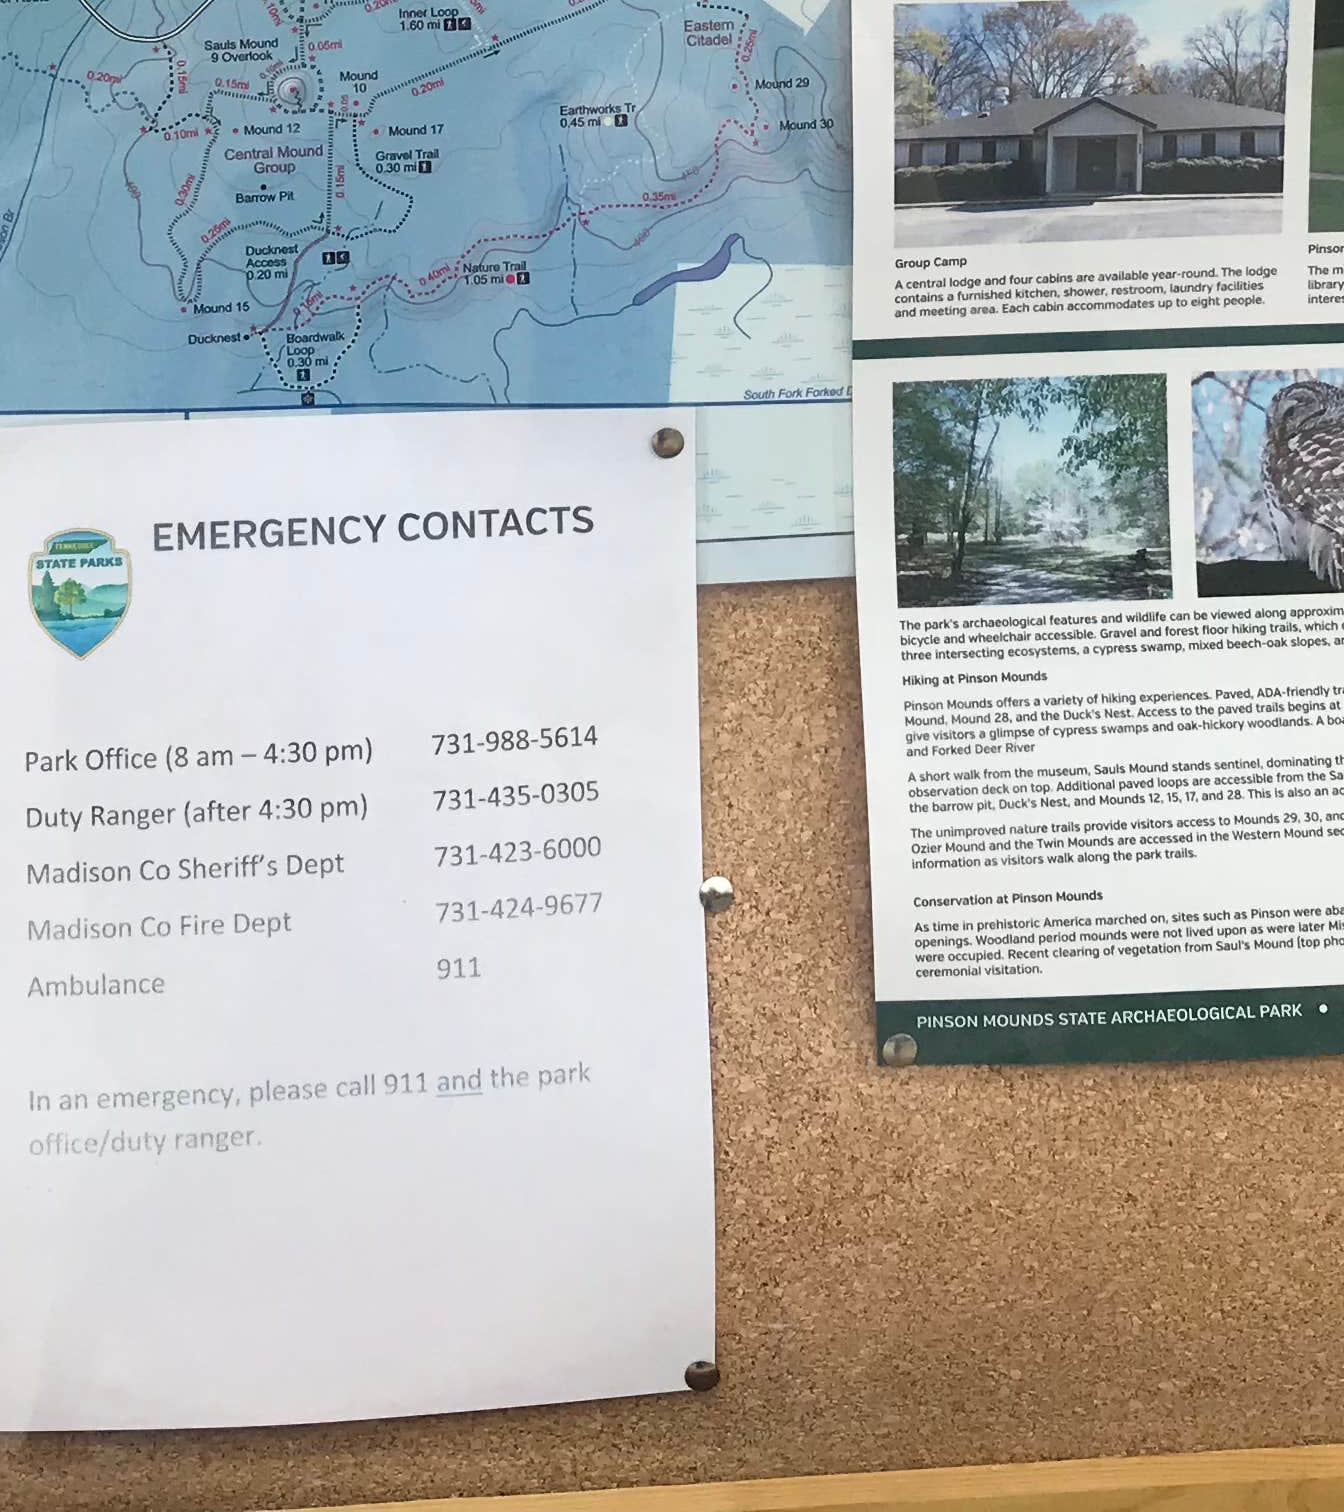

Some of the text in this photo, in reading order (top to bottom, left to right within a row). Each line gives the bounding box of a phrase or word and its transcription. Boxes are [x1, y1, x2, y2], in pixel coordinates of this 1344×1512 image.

[224, 144, 324, 161] Central Mound
[253, 162, 297, 175] Group
[894, 256, 967, 270] Group Camp
[153, 505, 595, 552] EMERGENCY CONTACTS
[36, 557, 124, 569] STATE PARKS
[902, 670, 1048, 687] Hiking at Pinson Mounds
[25, 748, 79, 773] Park
[85, 746, 158, 771] Office
[165, 744, 189, 773] (8
[196, 749, 233, 767] am
[263, 740, 318, 765] 4:30
[325, 736, 373, 767] pm)
[431, 724, 599, 756] 731-988-5614
[432, 780, 599, 812] 731-435-0305
[26, 792, 368, 833] Duty Ranger (after 4:30 pm)
[433, 835, 602, 868] 731-423-6000
[27, 860, 132, 885] Madison
[139, 859, 170, 880] Co
[286, 853, 345, 880] Dept
[435, 891, 603, 924] 731-424-9677
[27, 911, 293, 942] Madison Co Fire Dept
[436, 956, 482, 980] 911
[27, 972, 166, 998] Ambulance
[916, 1002, 1302, 1028] PINSON MOUNDS STATE ARCHAEOLOGICAL PARK
[28, 1060, 591, 1112] In an emergency, please call 911 and the park
[28, 1127, 263, 1165] office/duty ranger.
